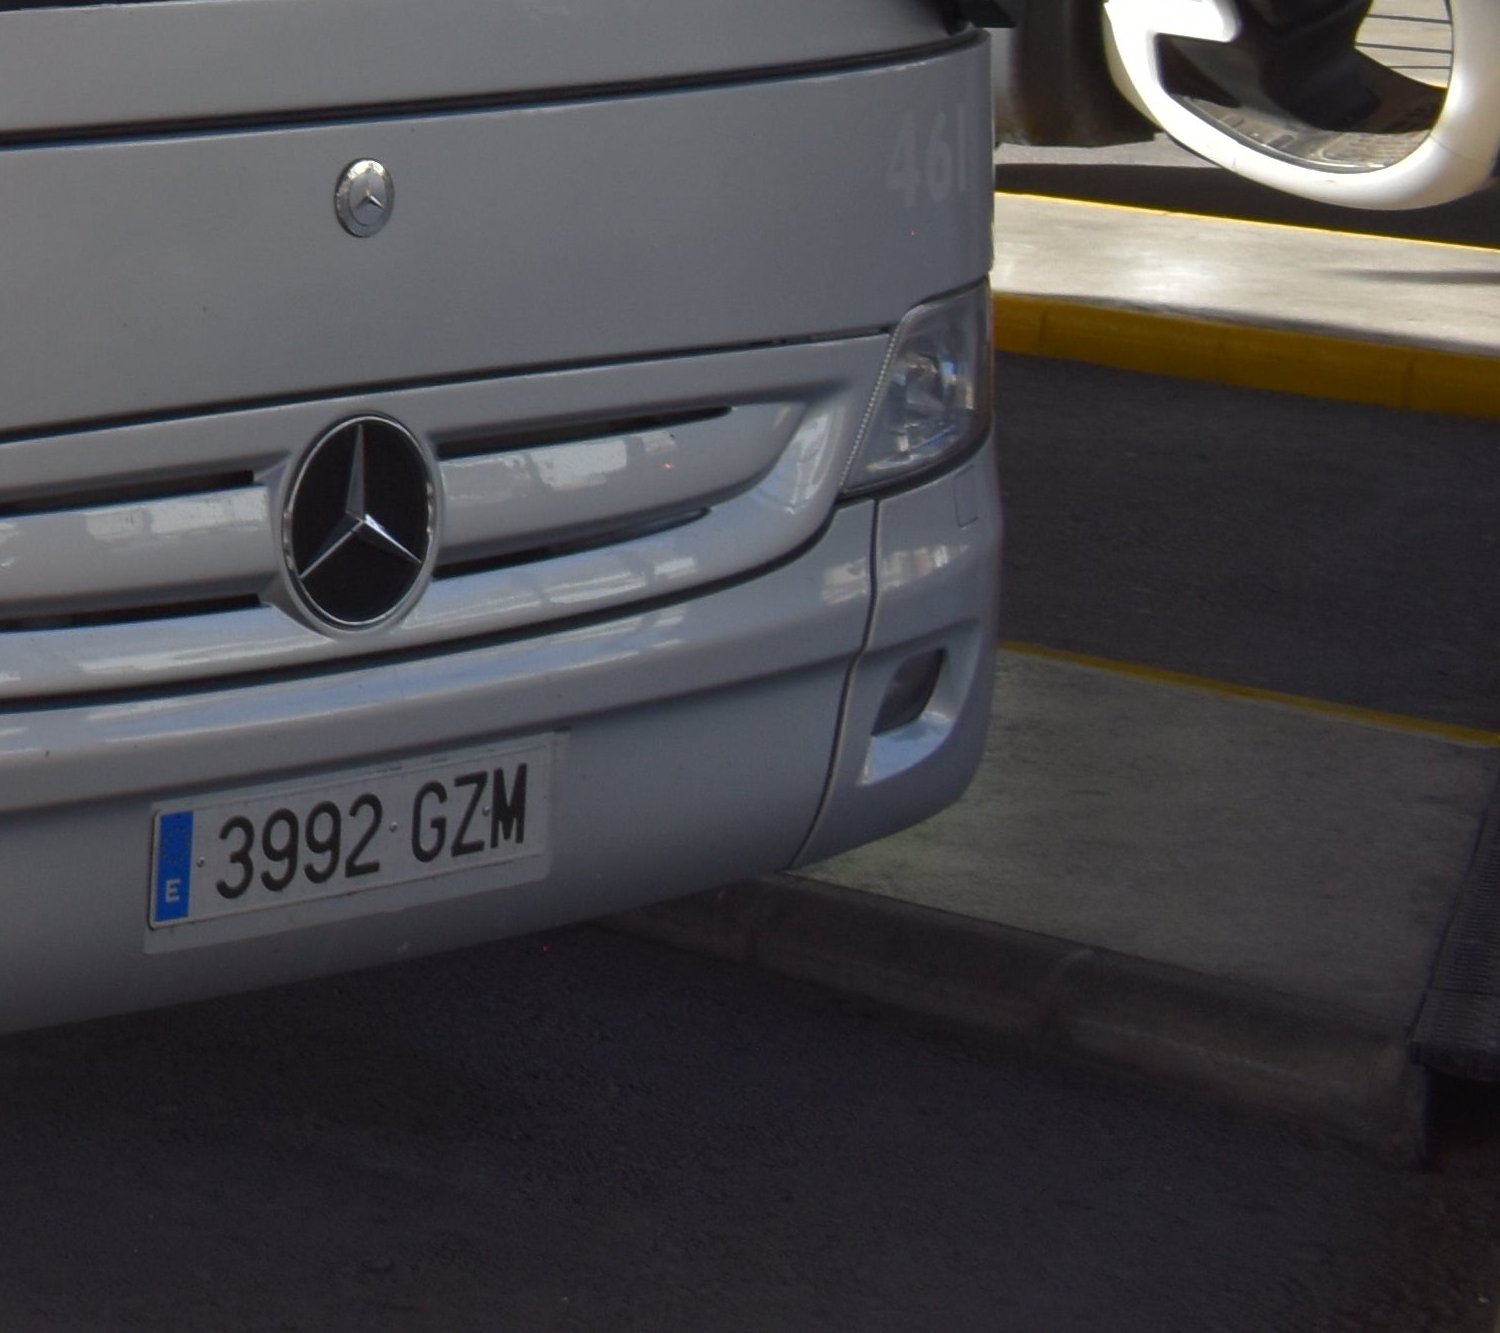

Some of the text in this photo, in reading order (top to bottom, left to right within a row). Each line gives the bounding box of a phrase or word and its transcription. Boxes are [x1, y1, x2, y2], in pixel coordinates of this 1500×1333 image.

[215, 762, 529, 900] 3992 GZM
[165, 878, 181, 904] E
